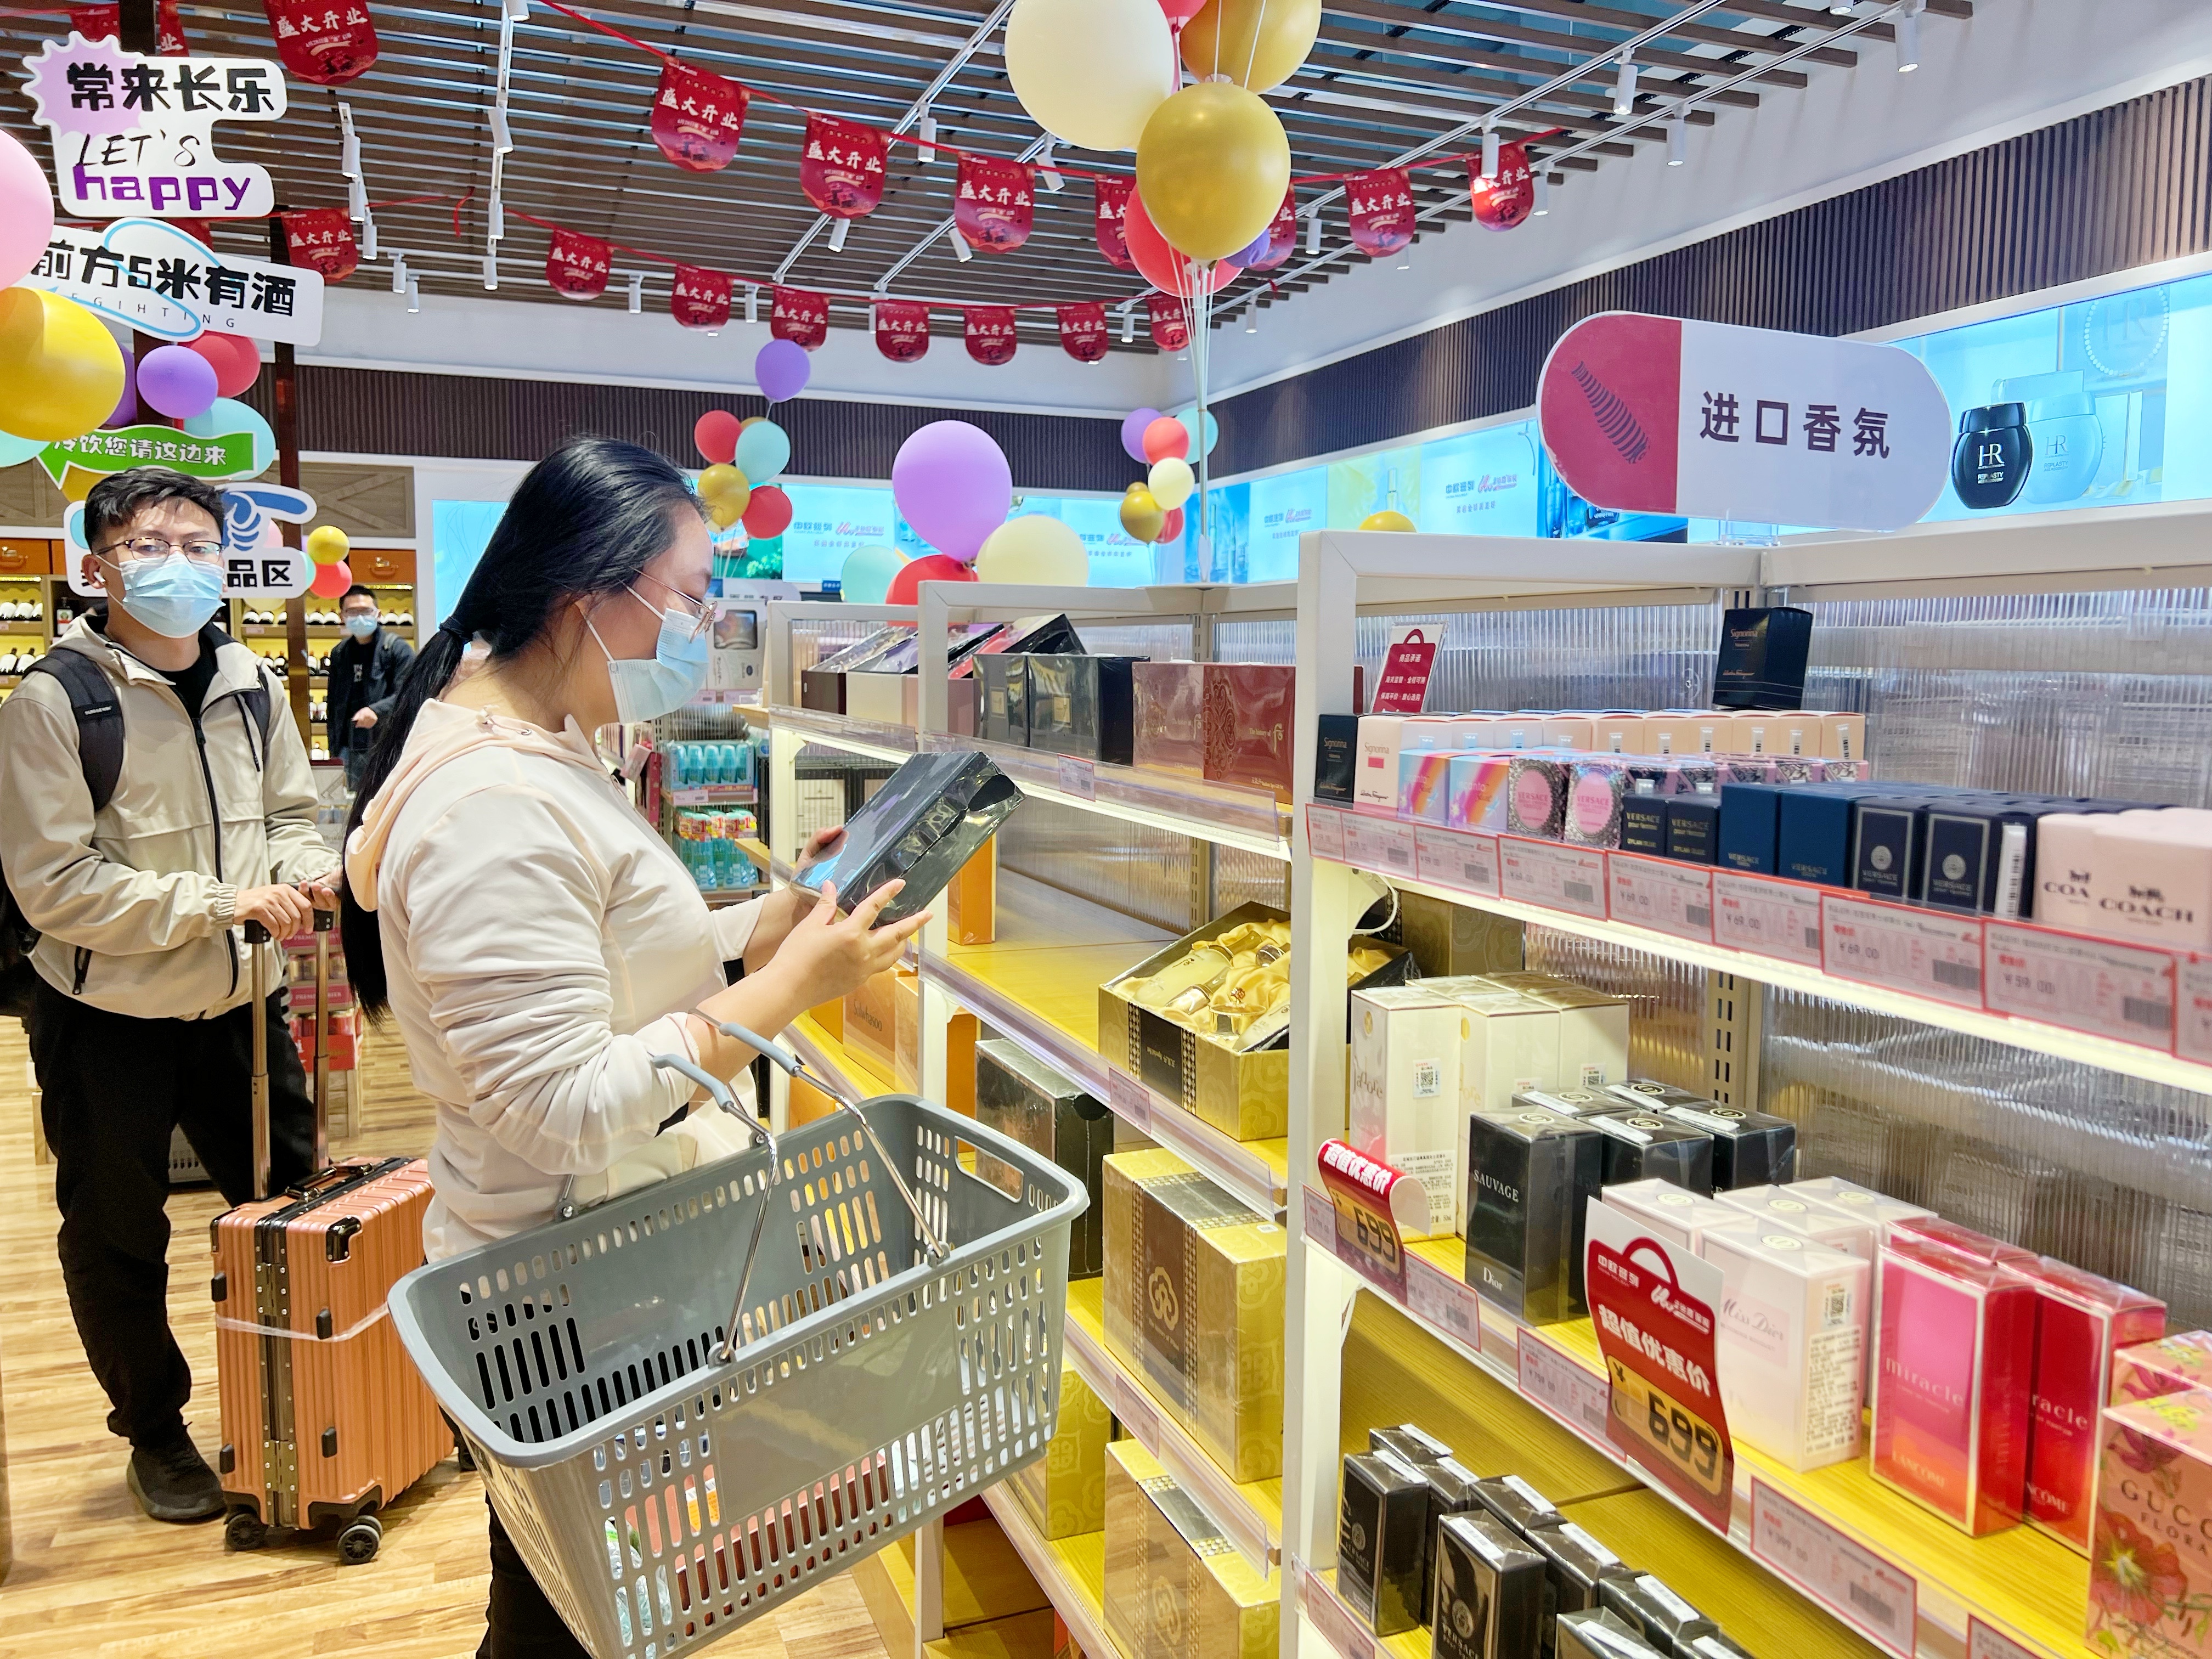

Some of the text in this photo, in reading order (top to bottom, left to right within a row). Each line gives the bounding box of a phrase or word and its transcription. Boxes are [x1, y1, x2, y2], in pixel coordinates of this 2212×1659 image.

[276, 7, 368, 39] 盛大开业
[66, 62, 275, 112] 常来长乐
[659, 87, 740, 131] 盛大开业
[75, 129, 200, 167] LET'S
[806, 140, 883, 173] 盛大开业
[73, 166, 250, 211] happy
[959, 179, 1031, 207] 盛大开业
[1098, 201, 1126, 219] 盛大
[1351, 192, 1411, 216] 盛大开业
[290, 229, 353, 247] 盛大开业
[551, 246, 607, 273] 盛大开业
[675, 281, 729, 306] 盛大开业
[773, 304, 826, 325] 盛大开业
[878, 318, 928, 333] 盛大开业
[1060, 320, 1106, 334] 盛大开业
[966, 322, 1015, 336] 盛大开业
[1700, 391, 1891, 459] 进口香氛
[1978, 443, 2005, 466] HR
[1364, 742, 1390, 755] Signorina
[1517, 792, 1549, 802] VERSACE
[1576, 795, 1610, 805] VERSACE
[1627, 812, 1660, 823] VERSACE
[1672, 819, 1709, 830] VERSACE
[2044, 881, 2091, 900] COA
[2099, 898, 2194, 924] COACH
[1323, 1142, 1393, 1196] 超值优惠价
[1472, 1170, 1520, 1203] SAUVAGE
[1353, 1205, 1396, 1264] 699
[1482, 1266, 1504, 1293] Dior
[1723, 1298, 1750, 1325] Miss
[1751, 1312, 1784, 1341] Dior
[1598, 1304, 1711, 1398] 超值优惠价
[1885, 1356, 1965, 1407] miracle
[2032, 1392, 2089, 1432] racle
[1647, 1387, 1718, 1476] 699
[2121, 1479, 2212, 1543] GUCC
[2141, 1511, 2208, 1555] FLORA
